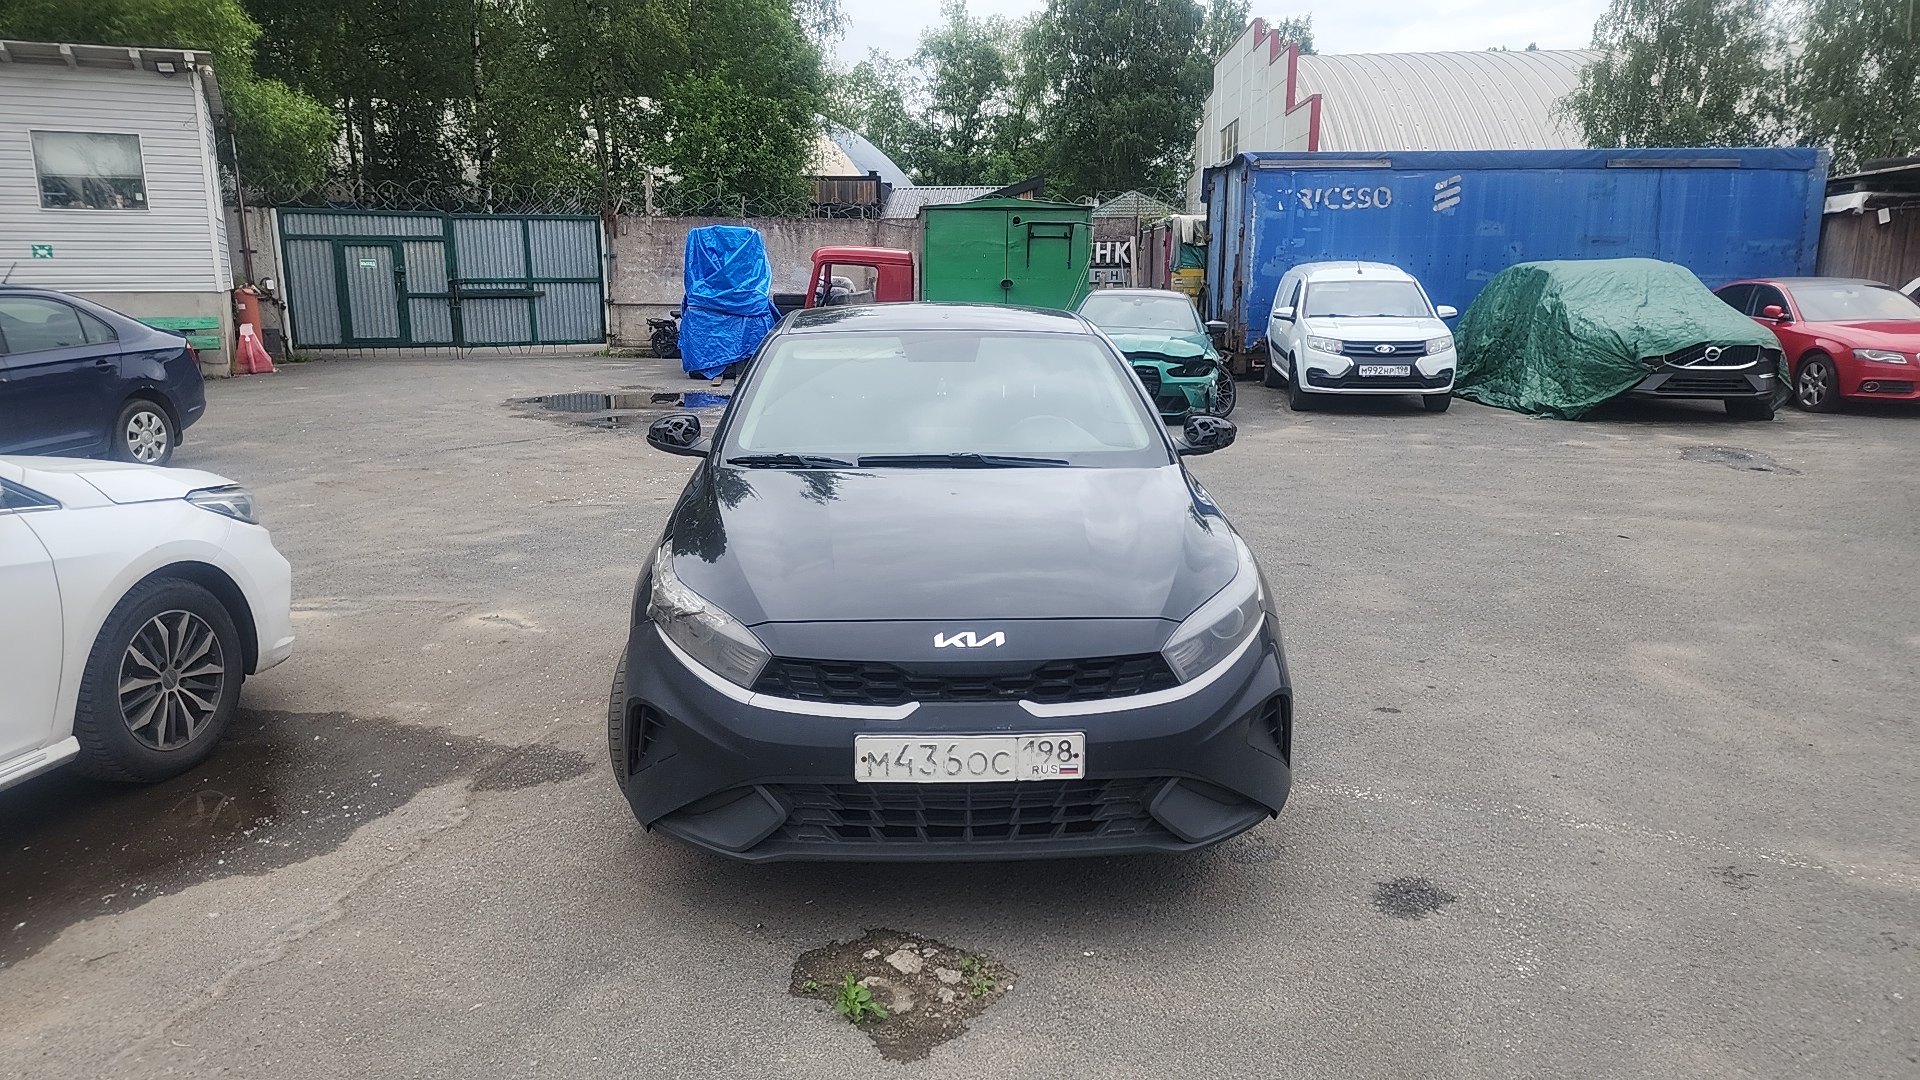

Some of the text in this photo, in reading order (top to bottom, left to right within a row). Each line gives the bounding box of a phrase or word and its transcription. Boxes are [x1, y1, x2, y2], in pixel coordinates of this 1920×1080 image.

[1361, 366, 1395, 375] М992НР
[933, 631, 1006, 648] KIA
[867, 739, 1073, 777] М436ОС 198
[1031, 765, 1058, 775] RUS
